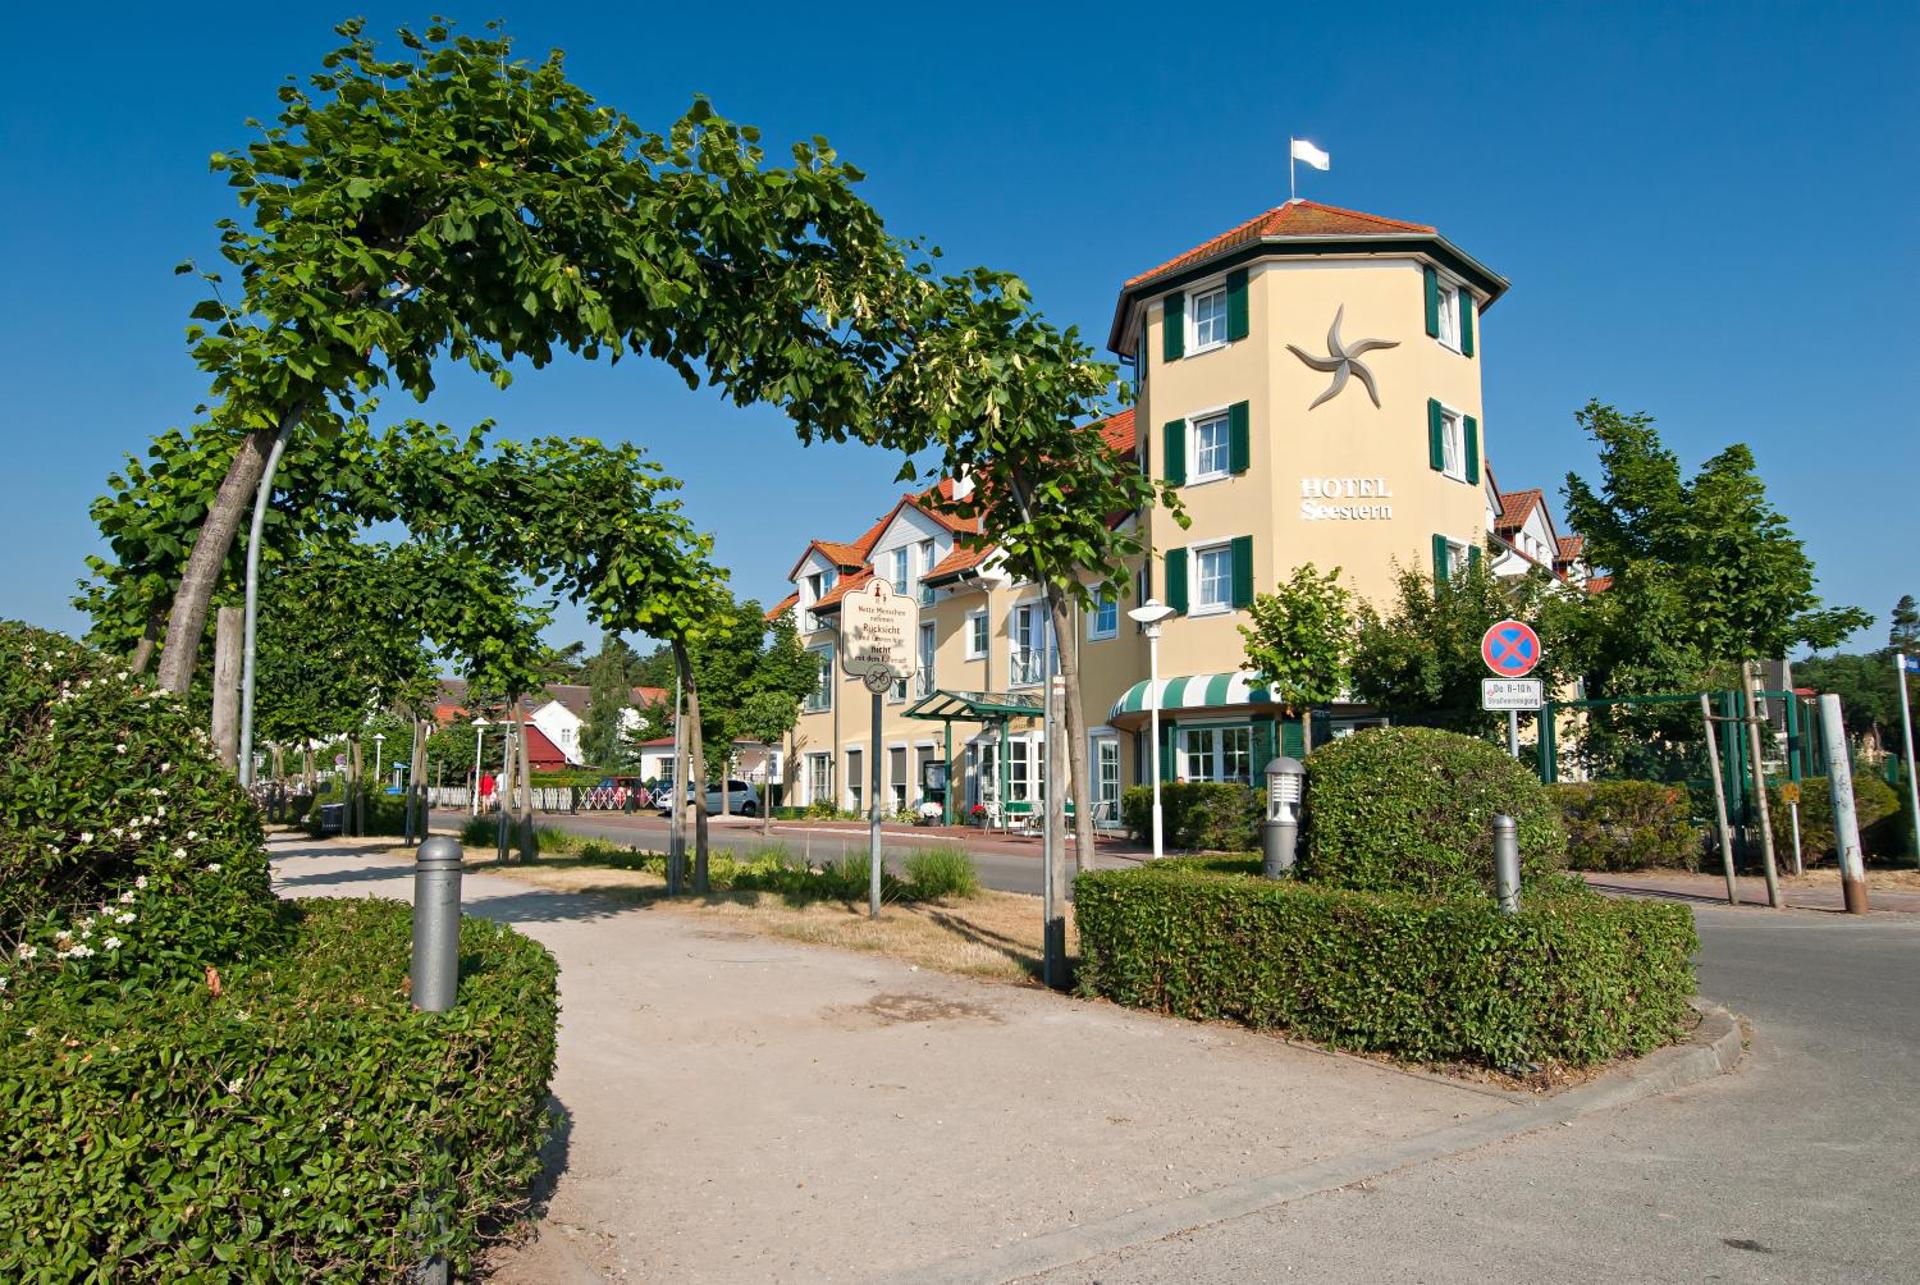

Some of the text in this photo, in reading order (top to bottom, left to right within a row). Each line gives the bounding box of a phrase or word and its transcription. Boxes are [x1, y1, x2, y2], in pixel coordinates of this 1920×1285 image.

[1300, 478, 1393, 498] HOTEL
[1300, 501, 1393, 521] Seestern
[863, 623, 900, 634] Rücksicht
[871, 645, 891, 653] nicht
